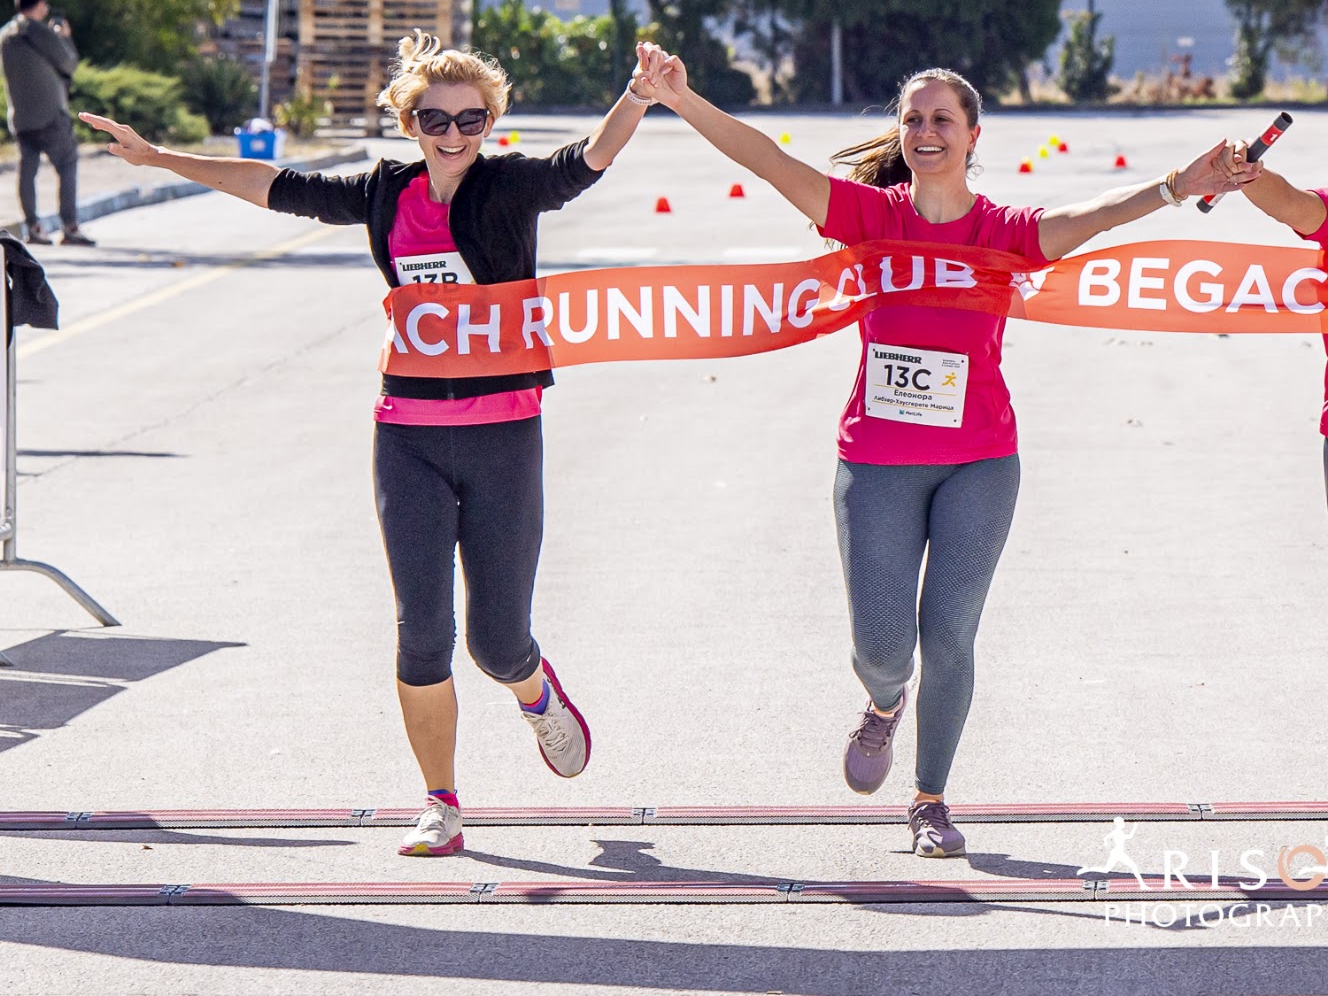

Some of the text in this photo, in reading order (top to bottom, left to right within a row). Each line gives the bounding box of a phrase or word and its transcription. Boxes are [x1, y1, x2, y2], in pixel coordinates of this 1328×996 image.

[402, 260, 447, 272] LIEBHERR
[521, 279, 821, 350] RUNNING
[874, 350, 922, 365] LIEBHERR
[883, 364, 932, 391] 13C
[894, 389, 933, 401] Елеонора
